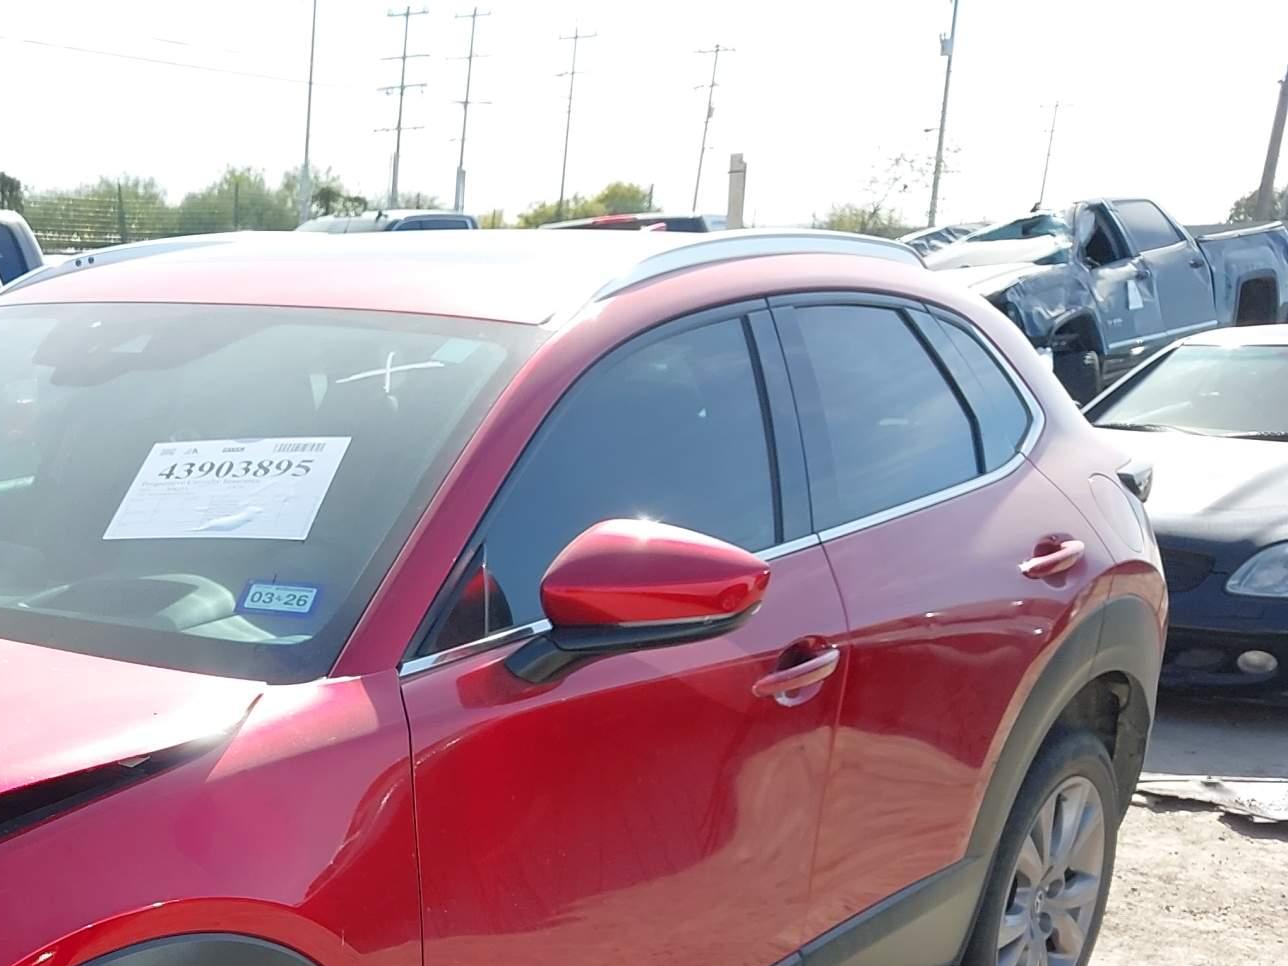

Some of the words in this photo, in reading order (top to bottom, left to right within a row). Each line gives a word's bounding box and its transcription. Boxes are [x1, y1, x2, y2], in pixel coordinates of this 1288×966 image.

[157, 458, 315, 480] 43903895
[250, 591, 275, 604] 03
[283, 593, 309, 607] 26
